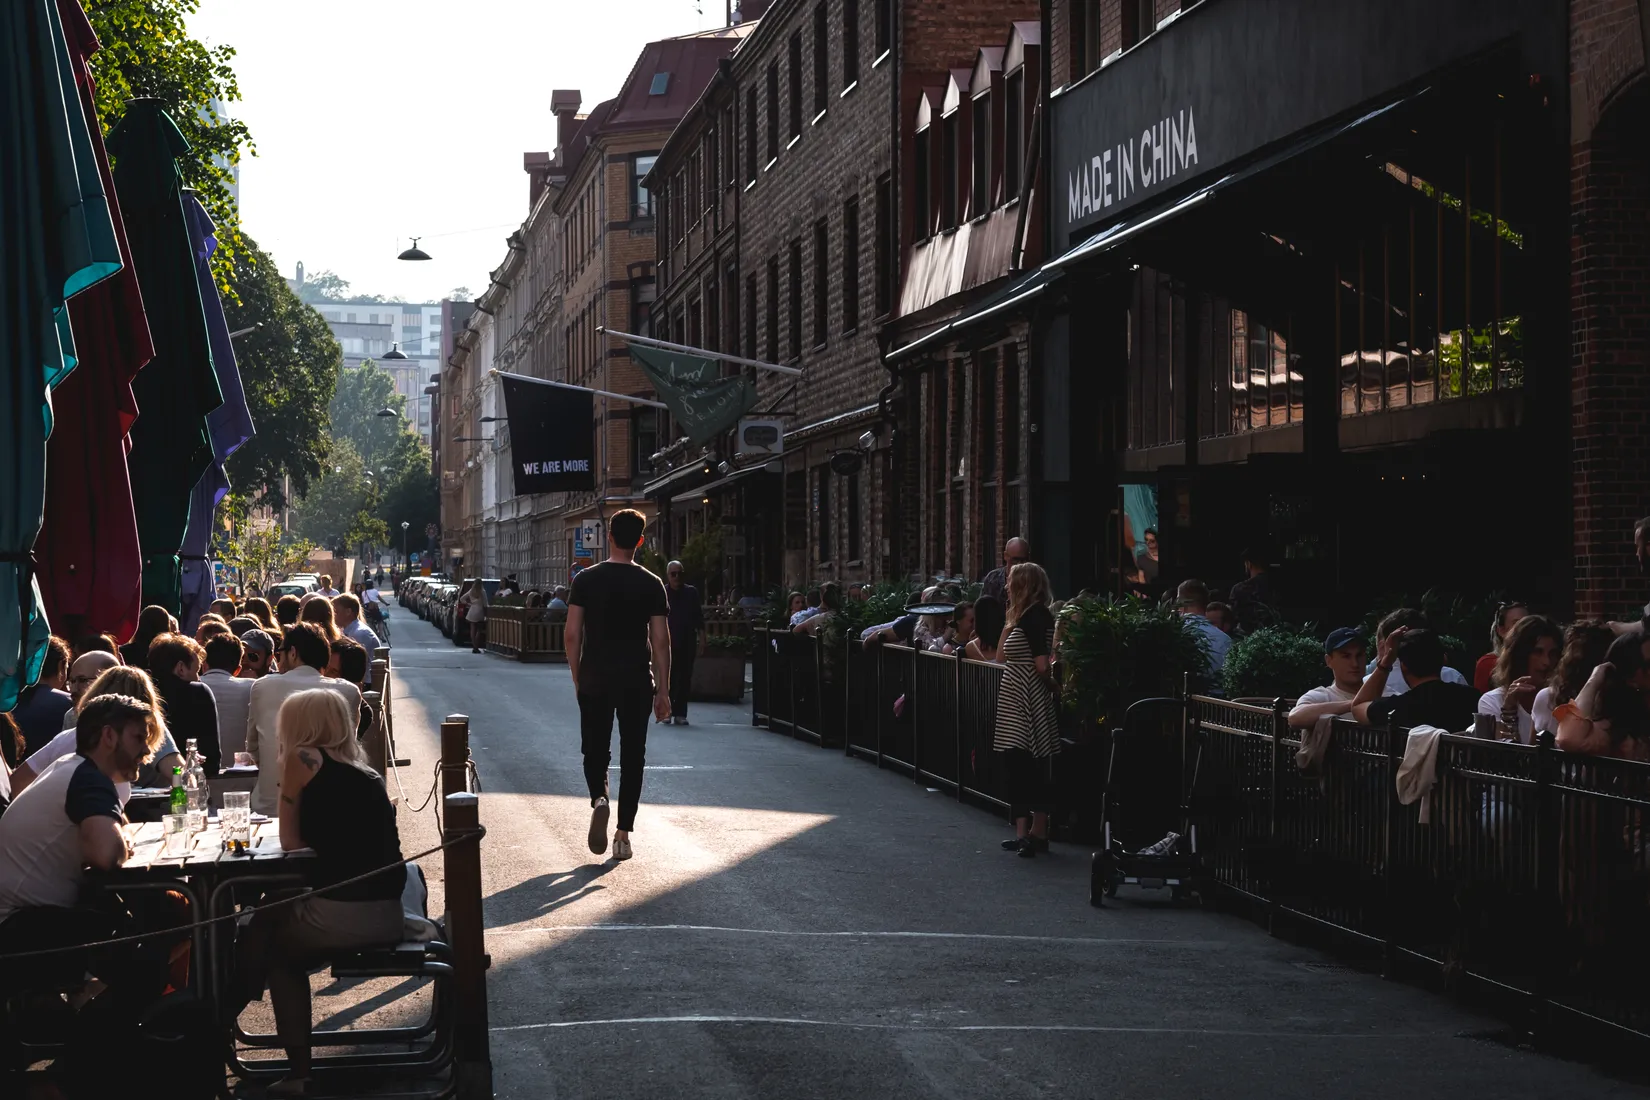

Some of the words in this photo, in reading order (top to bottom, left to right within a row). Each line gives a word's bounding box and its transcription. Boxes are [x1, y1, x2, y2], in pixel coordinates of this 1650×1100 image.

[1069, 149, 1112, 223] MADE
[1117, 138, 1135, 201] IN
[1140, 105, 1198, 188] CHINA
[523, 462, 540, 475] WE
[542, 461, 561, 474] ARE
[563, 460, 589, 472] MORE
